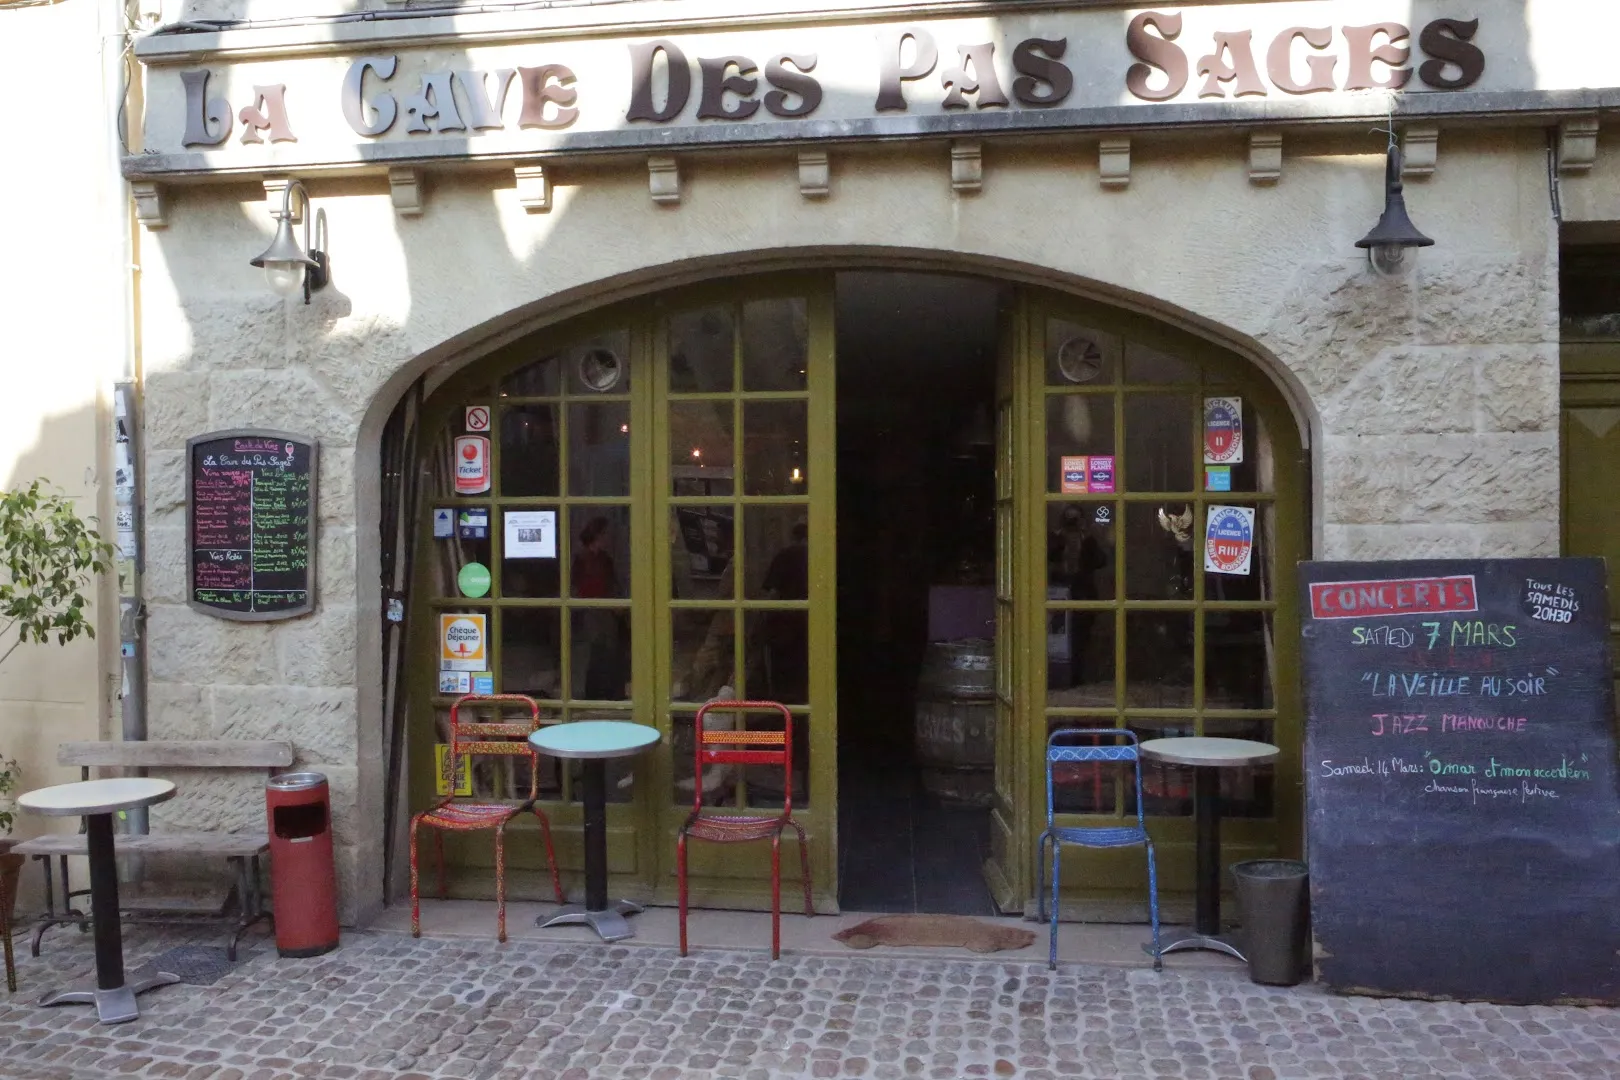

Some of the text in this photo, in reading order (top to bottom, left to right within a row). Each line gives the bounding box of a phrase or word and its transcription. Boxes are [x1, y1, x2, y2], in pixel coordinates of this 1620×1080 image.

[340, 54, 581, 138] CAVE
[624, 38, 823, 124] DES
[874, 24, 1075, 112] PAS
[1125, 10, 1486, 102] SAGES
[1215, 432, 1240, 461] BOISSONS
[203, 455, 217, 466] La
[241, 455, 252, 466] des
[459, 466, 482, 474] Ticket
[1212, 508, 1249, 528] VAUCLUSE
[1217, 529, 1242, 537] LICENCE
[1218, 545, 1239, 557] RIII
[1321, 581, 1470, 613] CONCERTS
[1526, 578, 1575, 598] TOUS LES
[1526, 591, 1580, 612] SAMEDIS
[1532, 605, 1573, 624] 20H30
[447, 633, 480, 642] Déjeuner
[449, 626, 477, 634] Chèque
[1421, 621, 1441, 650] 7
[1451, 620, 1517, 648] MARS
[1480, 675, 1500, 696] AU
[1371, 713, 1528, 736] JAZZ MANOUCHE
[1321, 756, 1375, 777] Samedi
[1378, 760, 1390, 777] 14
[1485, 756, 1501, 778] et
[1501, 767, 1531, 777] mon
[1424, 779, 1470, 793] chanson
[1522, 780, 1560, 804] festive
